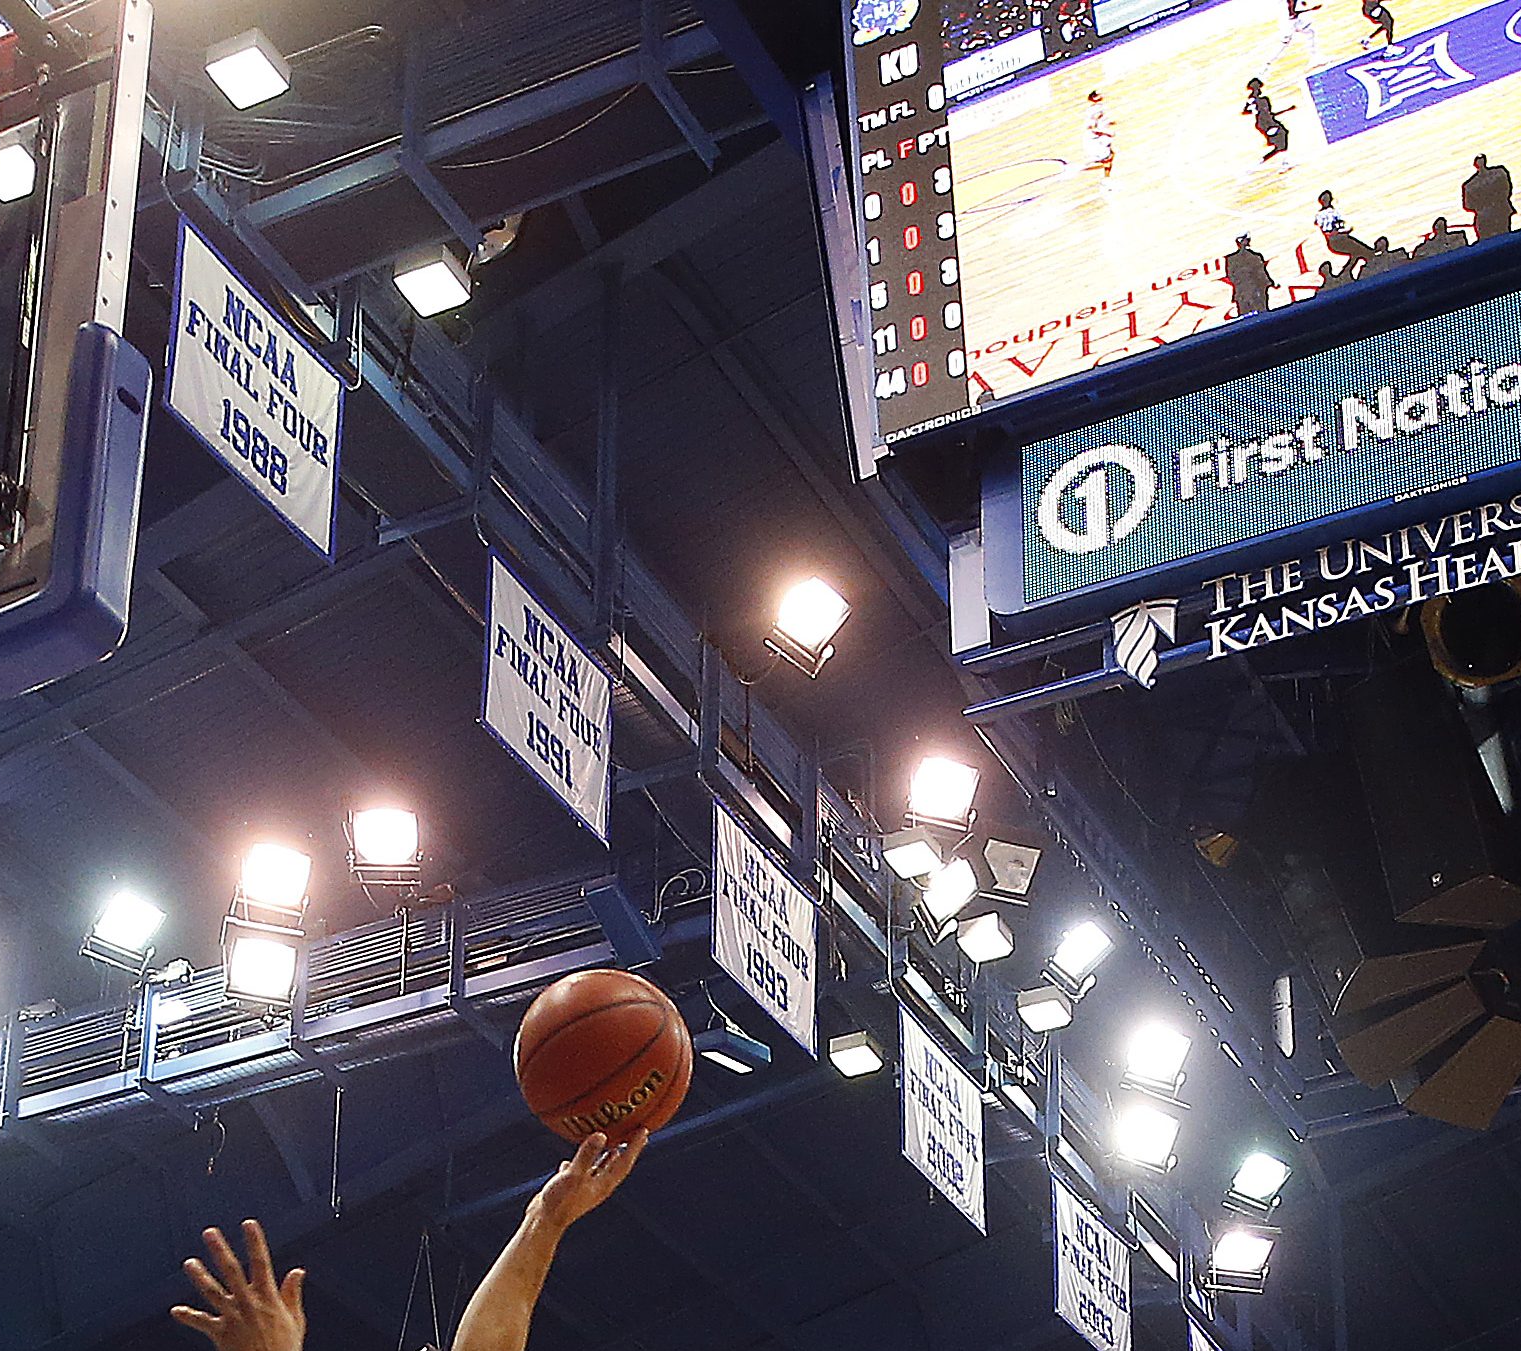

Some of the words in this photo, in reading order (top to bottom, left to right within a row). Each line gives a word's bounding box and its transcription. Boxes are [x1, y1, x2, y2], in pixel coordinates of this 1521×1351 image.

[879, 43, 920, 86] KU
[858, 109, 887, 132] TM
[888, 100, 916, 122] FL
[861, 149, 893, 174] PL
[897, 138, 916, 159] F
[863, 192, 882, 221] 0
[900, 181, 918, 206] 0
[933, 165, 952, 195] 3
[866, 236, 881, 265] 1
[903, 225, 921, 250] 0
[936, 211, 955, 240] 3
[869, 280, 888, 310] 5
[906, 270, 924, 296] 0
[939, 257, 959, 287] 3
[222, 284, 298, 397] NCAA
[872, 323, 898, 355] 11
[910, 315, 927, 341] 0
[942, 301, 963, 330] 0
[185, 299, 259, 402] FINAL
[266, 382, 328, 468] FOUR
[875, 366, 908, 400] 44
[912, 361, 929, 387] 0
[947, 348, 966, 378] 0
[220, 398, 289, 495] 1988
[885, 404, 982, 443] DAKTRONICS
[1177, 413, 1324, 501] First
[1394, 474, 1469, 504] DAKTRONICS
[1202, 558, 1305, 616] THE
[1204, 575, 1398, 661] KANSAS
[523, 604, 581, 699] NCAA
[495, 623, 552, 709] FINAL
[557, 688, 602, 761] FOUR
[527, 710, 574, 789] 1991
[743, 848, 790, 926] NCAA
[746, 943, 789, 1012] 1993
[772, 920, 810, 982] FOUR
[561, 1067, 666, 1136] Wilson
